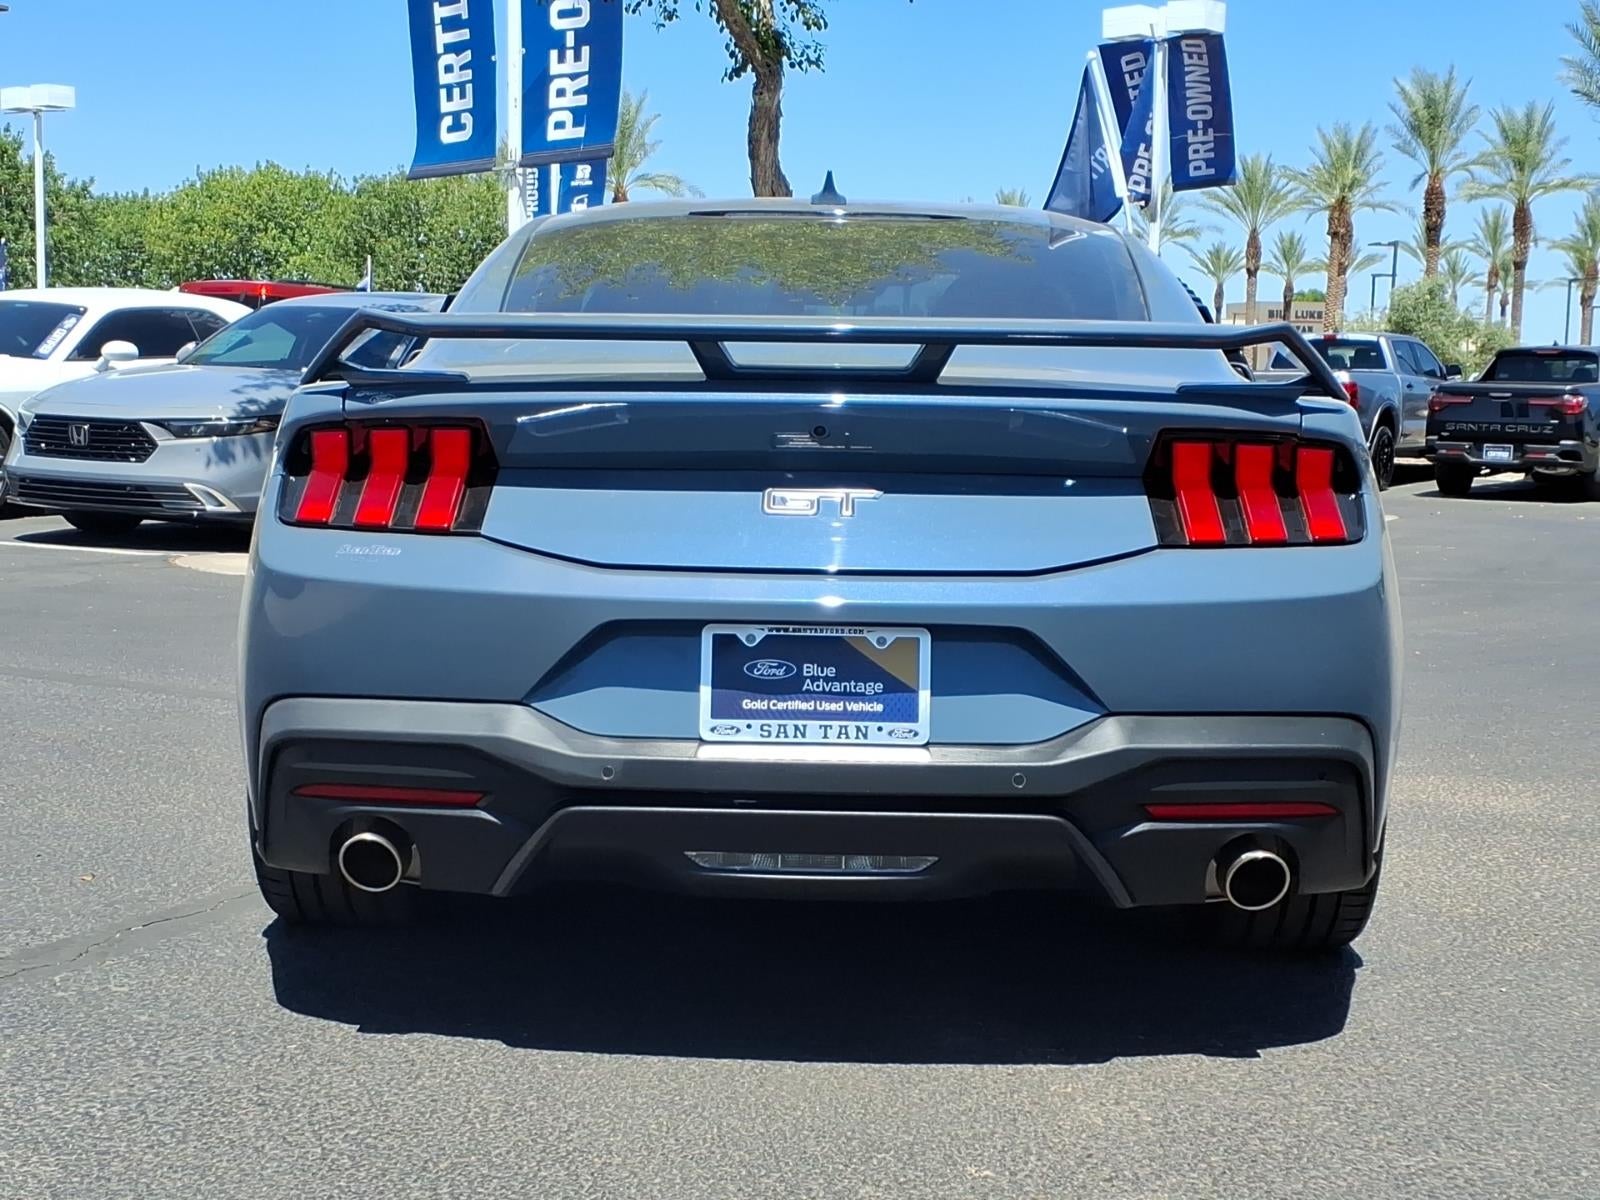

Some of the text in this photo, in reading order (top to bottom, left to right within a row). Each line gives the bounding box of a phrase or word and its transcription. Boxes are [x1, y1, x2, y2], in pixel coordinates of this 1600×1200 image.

[432, 0, 474, 144] CERTI
[546, 0, 591, 142] PRE-O
[1180, 38, 1217, 178] PRE-OWNED
[1295, 310, 1323, 319] LUKE
[1445, 422, 1554, 434] SANTA CRUZ
[762, 487, 884, 517] GT
[753, 661, 787, 676] Ford
[803, 664, 836, 677] Blue
[802, 679, 884, 695] Advantage
[742, 699, 884, 712] Gold Certified Used Vehicle
[712, 724, 739, 735] Ford
[759, 723, 870, 740] SAN TAN
[890, 727, 917, 738] Ford
